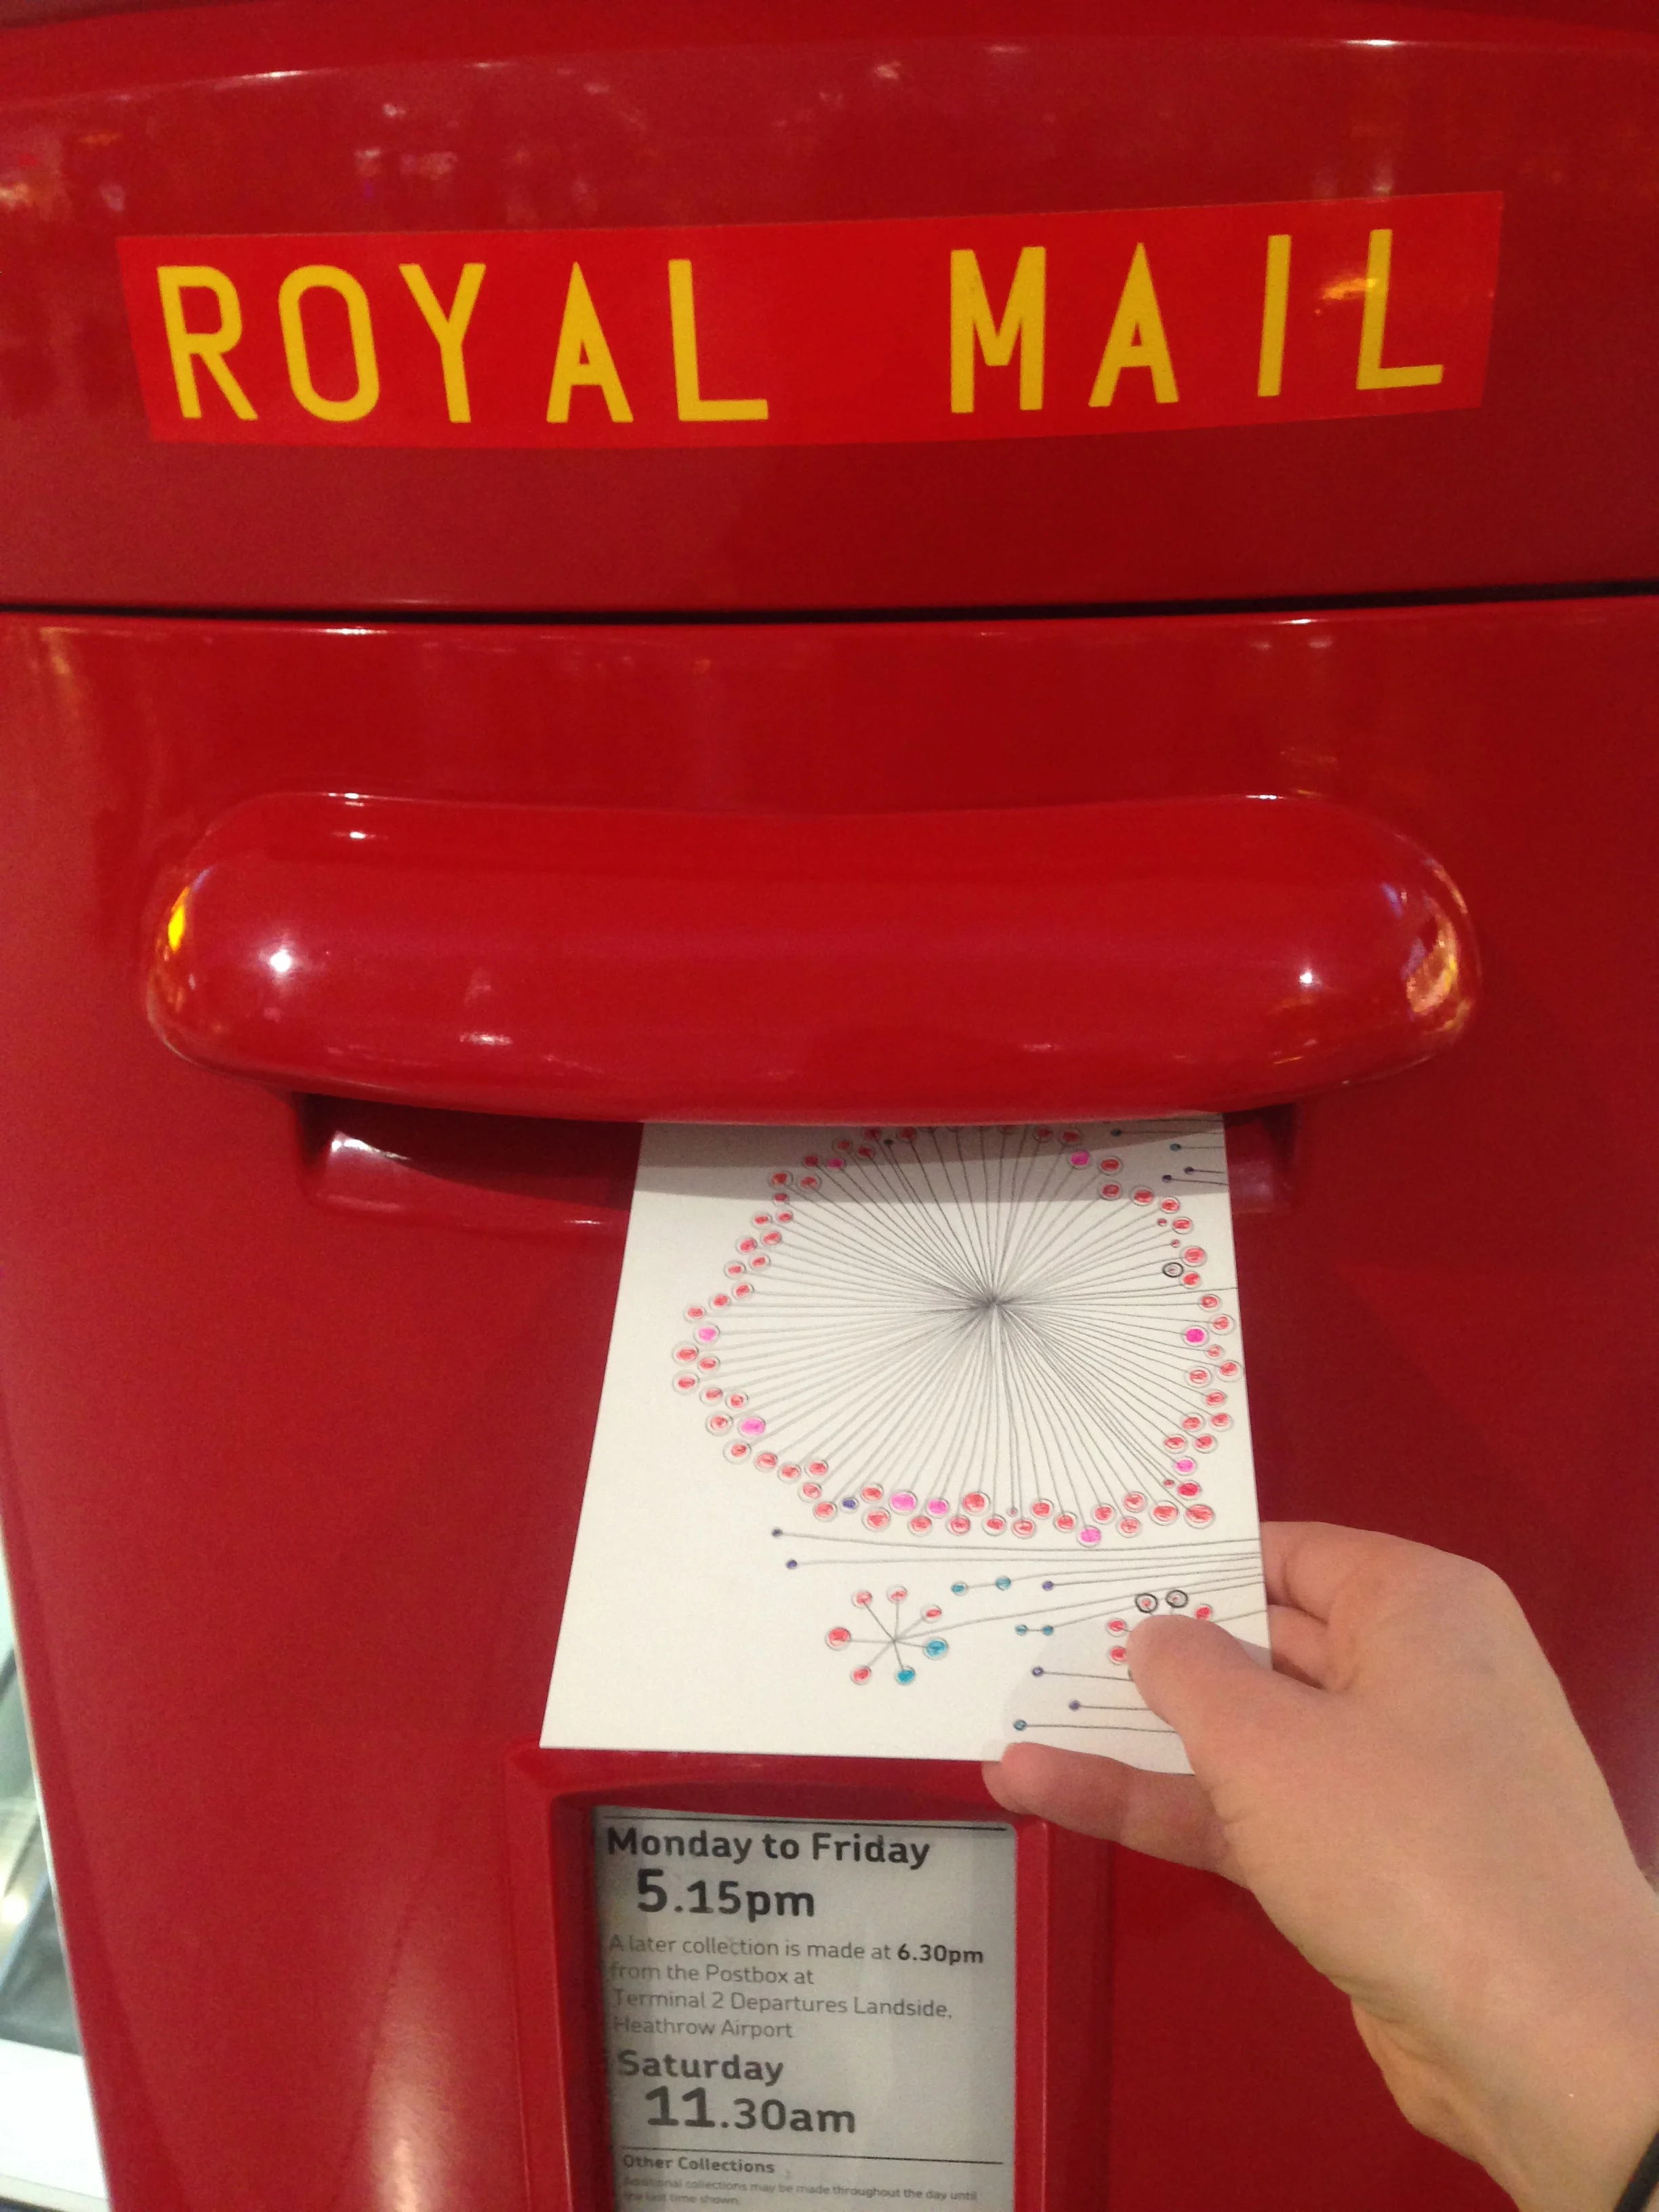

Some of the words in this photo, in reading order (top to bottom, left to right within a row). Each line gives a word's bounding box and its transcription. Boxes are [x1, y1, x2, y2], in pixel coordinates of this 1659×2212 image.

[157, 259, 769, 424] ROYAL
[950, 228, 1444, 413] MAIL
[609, 1826, 752, 1864] Monday
[762, 1832, 800, 1861] to
[813, 1832, 930, 1870] Friday
[636, 1867, 815, 1923] 5.15pm
[609, 1934, 624, 1952] A
[629, 1935, 676, 1953] later
[682, 1937, 779, 1957] collection
[785, 1939, 800, 1957] is
[807, 1941, 865, 1960] made
[871, 1944, 891, 1961] at
[897, 1942, 984, 1965] 6.30pm
[611, 1963, 661, 1981] from
[667, 1963, 699, 1981] the
[706, 1964, 788, 1984] Postbox
[794, 1969, 815, 1985] at
[613, 1988, 705, 2009] Terminal
[712, 1991, 724, 2010] 2
[731, 1992, 848, 2014] Departures
[854, 1996, 952, 2019] Landside,
[613, 2016, 715, 2035] Heathrow
[721, 2019, 794, 2040] Airport
[617, 2049, 783, 2086] Saturday
[645, 2085, 855, 2133] 11.30am
[623, 2154, 673, 2169] Other
[678, 2156, 775, 2174] Collections
[684, 2178, 747, 2191] collections
[750, 2182, 776, 2194] may
[778, 2182, 794, 2193] be
[796, 2184, 831, 2194] made
[832, 2185, 900, 2198] throughout
[903, 2188, 923, 2198] the
[925, 2190, 947, 2200] day
[950, 2190, 978, 2201] until
